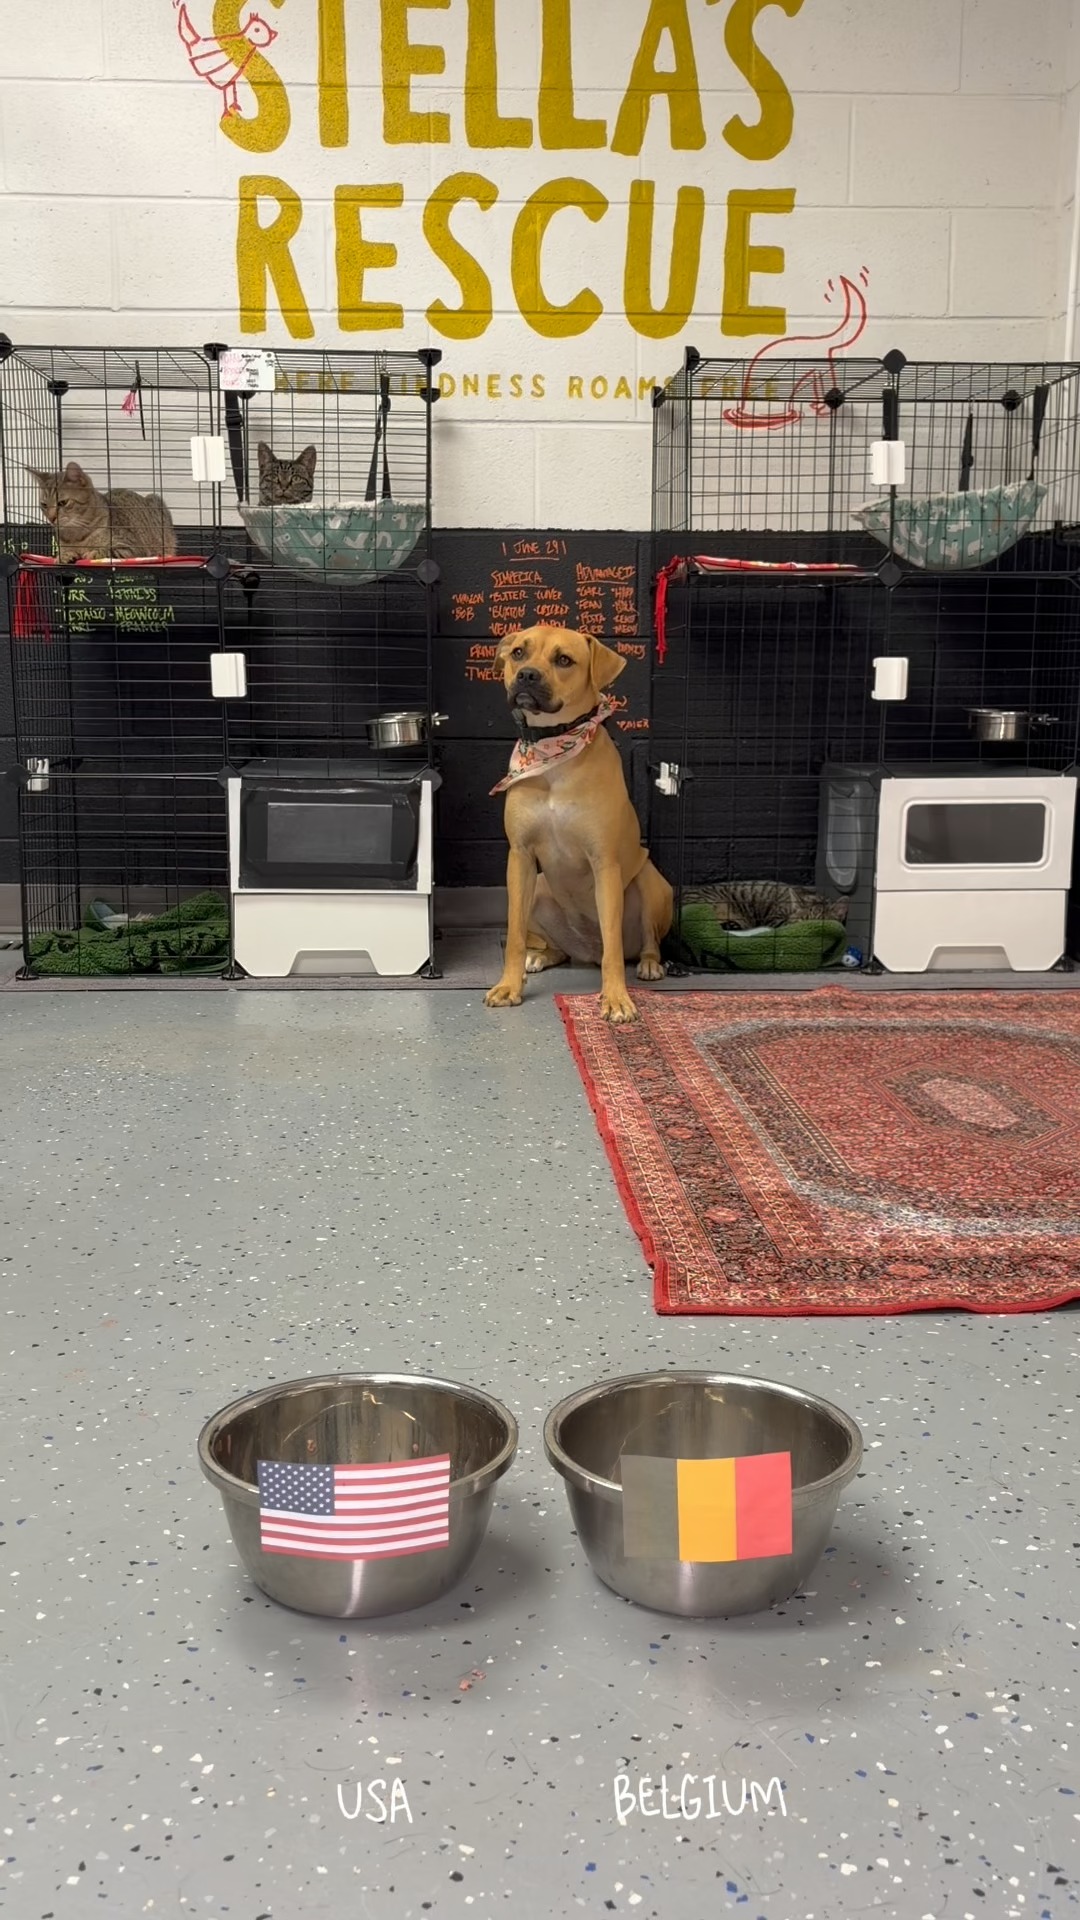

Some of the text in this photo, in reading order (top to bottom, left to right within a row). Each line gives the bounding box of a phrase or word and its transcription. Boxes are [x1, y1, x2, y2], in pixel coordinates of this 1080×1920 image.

[213, 0, 801, 160] STELLAS
[236, 171, 796, 339] RESCUE
[398, 372, 546, 398] INDNESS
[568, 375, 675, 399] ROAMS
[513, 539, 539, 554] JUNE
